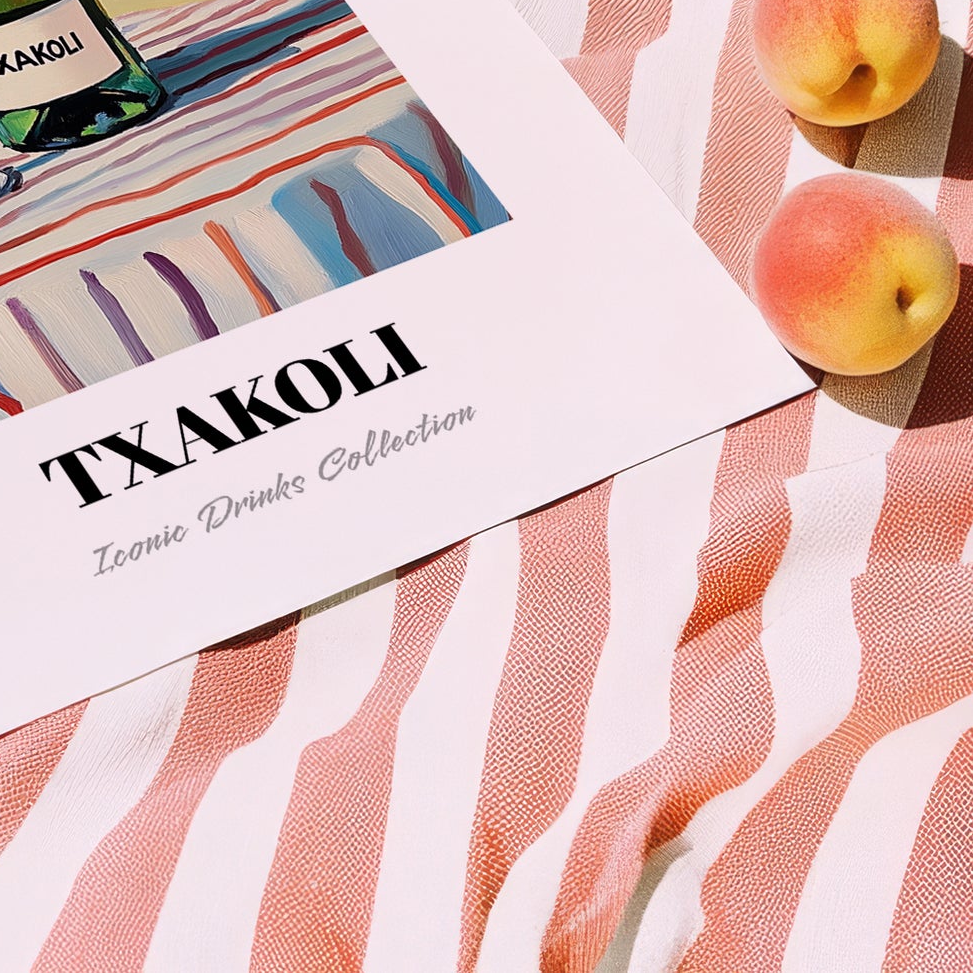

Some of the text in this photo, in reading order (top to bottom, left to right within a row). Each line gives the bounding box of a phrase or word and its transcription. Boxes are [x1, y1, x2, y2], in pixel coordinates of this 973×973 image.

[38, 322, 428, 509] TXAKOLI
[93, 404, 477, 577] Iconic Drinks Collection
